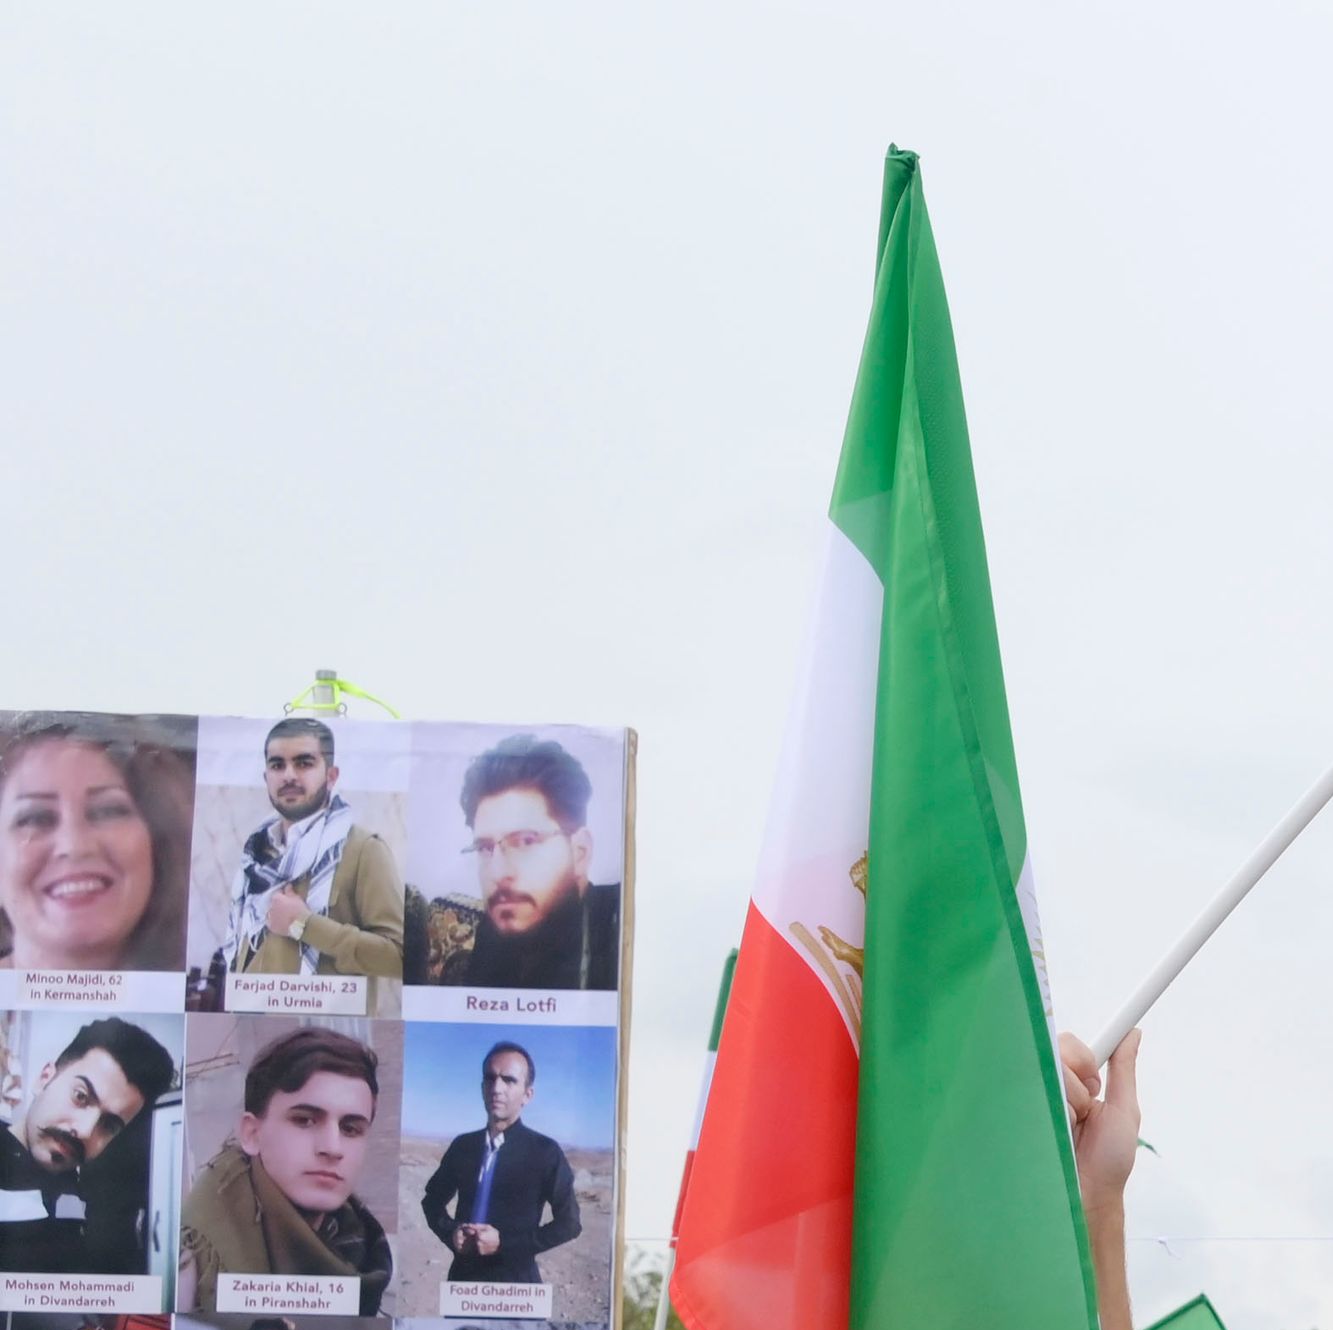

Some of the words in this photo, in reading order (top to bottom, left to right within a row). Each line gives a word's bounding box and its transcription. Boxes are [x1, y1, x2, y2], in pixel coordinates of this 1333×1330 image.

[108, 975, 122, 986] 62
[235, 980, 275, 994] Farjad
[279, 981, 336, 994] Darvishi,
[341, 982, 357, 993] 23
[44, 989, 117, 1001] Kermanshah
[268, 996, 279, 1007] in
[284, 996, 323, 1008] Urmia
[466, 996, 509, 1011] Reza
[516, 997, 557, 1012] Lotfi
[5, 1279, 55, 1291] Mohsen
[59, 1280, 135, 1292] Mohammadi
[232, 1280, 281, 1292] Zakaria
[329, 1283, 344, 1294] 16
[450, 1285, 478, 1296] Foad
[535, 1287, 546, 1297] in
[24, 1295, 35, 1306] in
[40, 1295, 116, 1307] Divandarreh
[244, 1296, 257, 1307] in
[262, 1297, 332, 1309] Piranshahr
[461, 1301, 534, 1312] Divandarreh
